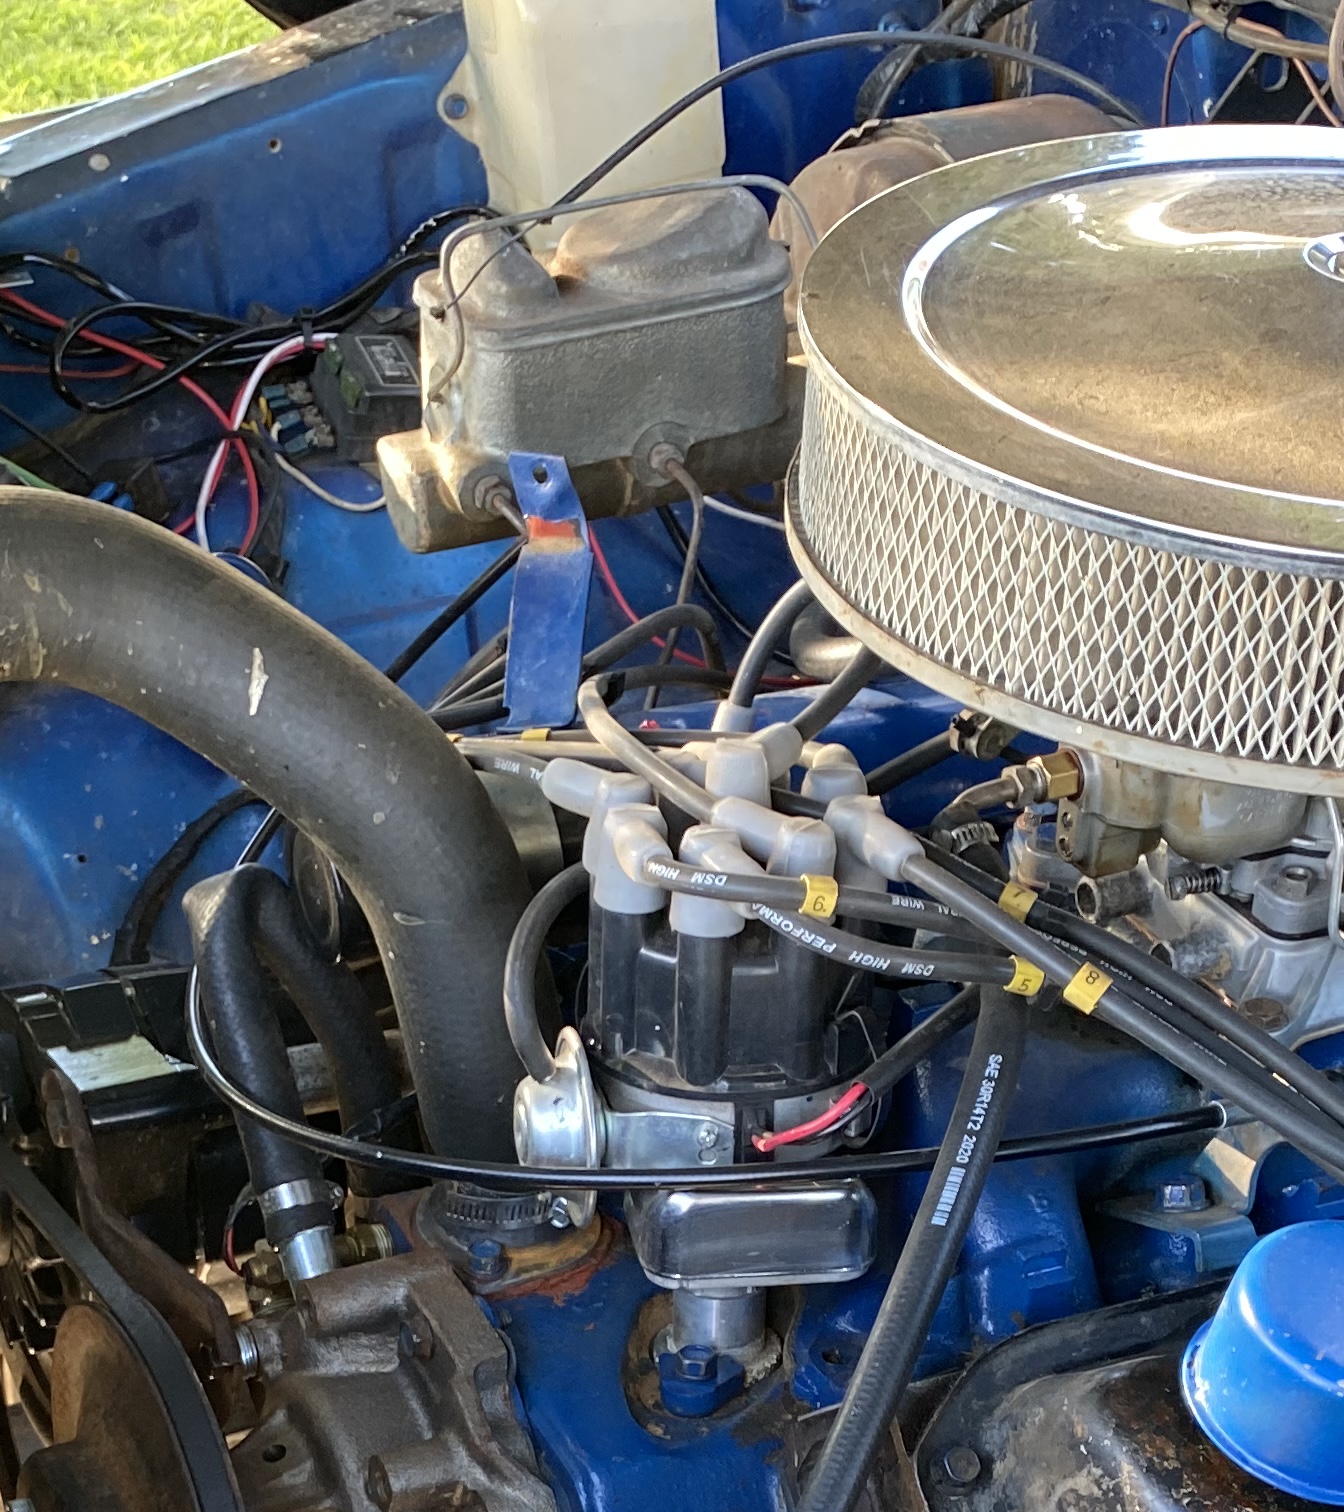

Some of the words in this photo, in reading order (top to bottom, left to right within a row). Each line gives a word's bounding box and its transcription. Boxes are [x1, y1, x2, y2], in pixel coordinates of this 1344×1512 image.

[691, 872, 727, 886] DSM
[891, 894, 925, 911] WIRE
[752, 902, 837, 954] PERFORMA
[848, 949, 891, 971] HIGH
[901, 961, 935, 977] DSM
[1017, 978, 1032, 993] 5
[1085, 970, 1101, 985] 8
[984, 1053, 1003, 1079] SAE
[966, 1077, 996, 1131] 30R14T2
[956, 1134, 977, 1164] 2020
